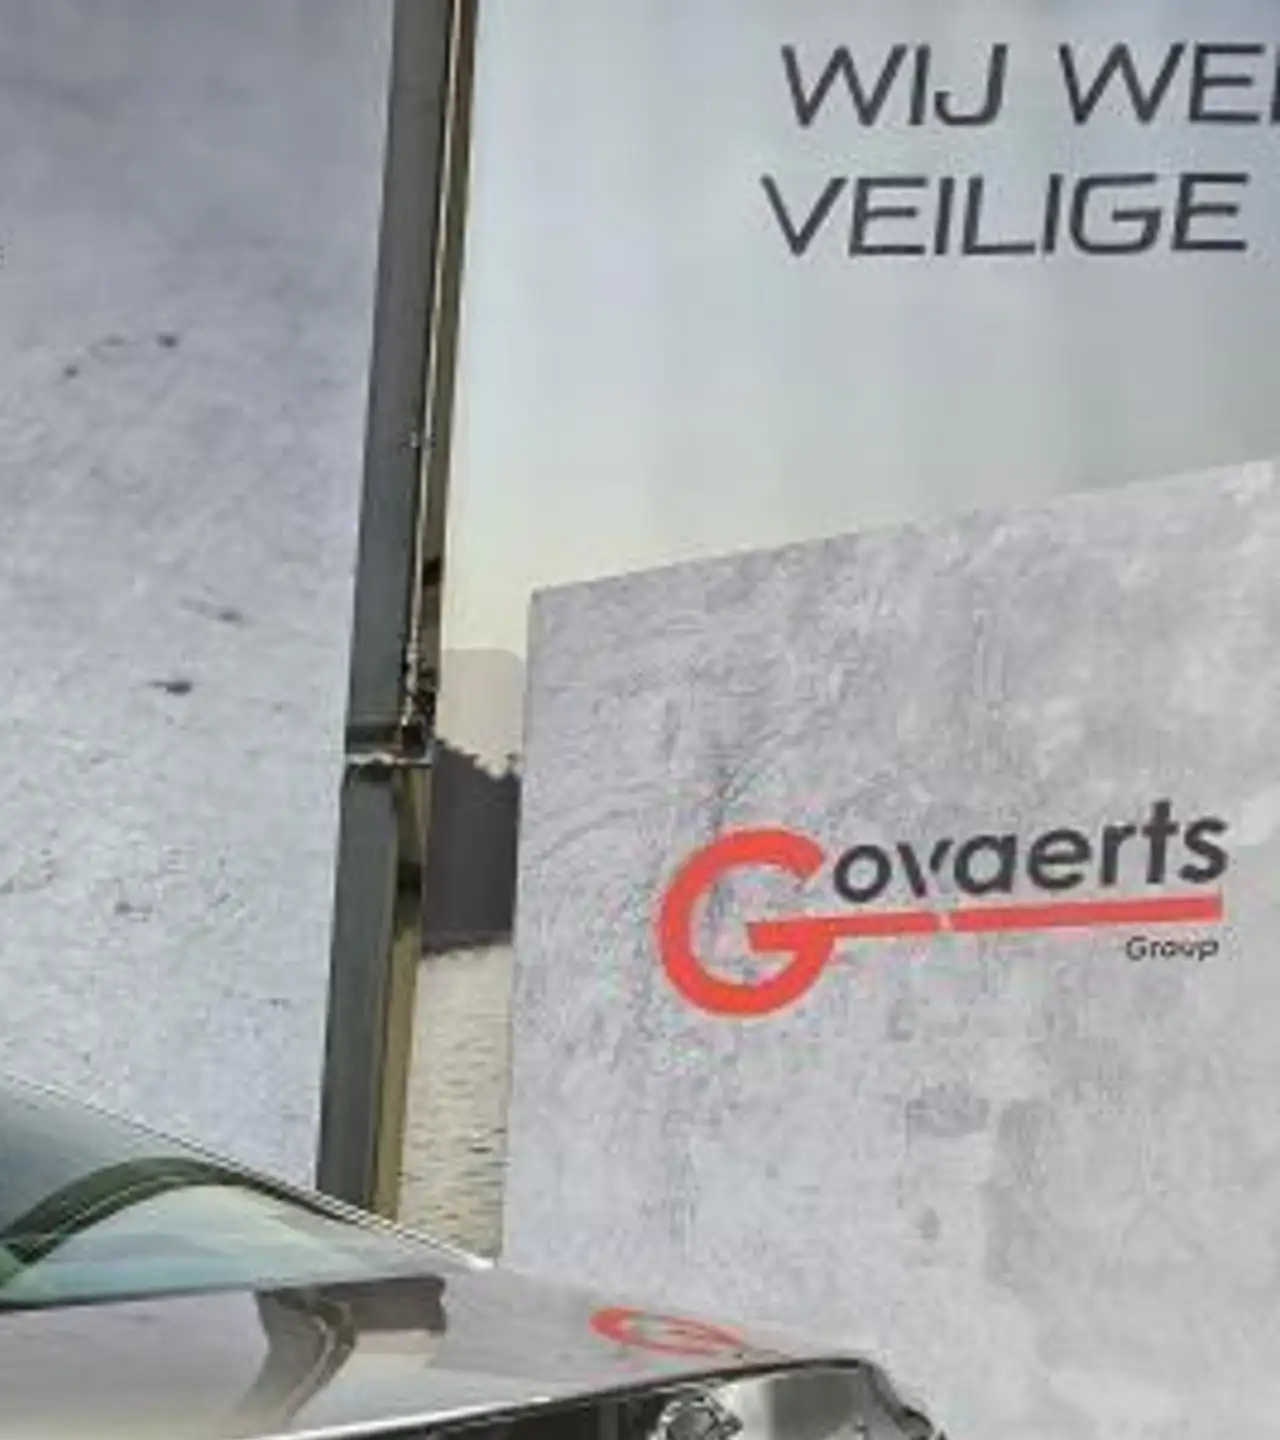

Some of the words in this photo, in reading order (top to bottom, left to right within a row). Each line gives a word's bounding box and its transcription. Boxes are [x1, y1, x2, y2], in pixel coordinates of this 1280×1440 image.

[781, 42, 1008, 127] WIJ
[761, 172, 1249, 258] VEILIGE
[660, 799, 1229, 1017] Govaerts
[1125, 936, 1219, 962] Group
